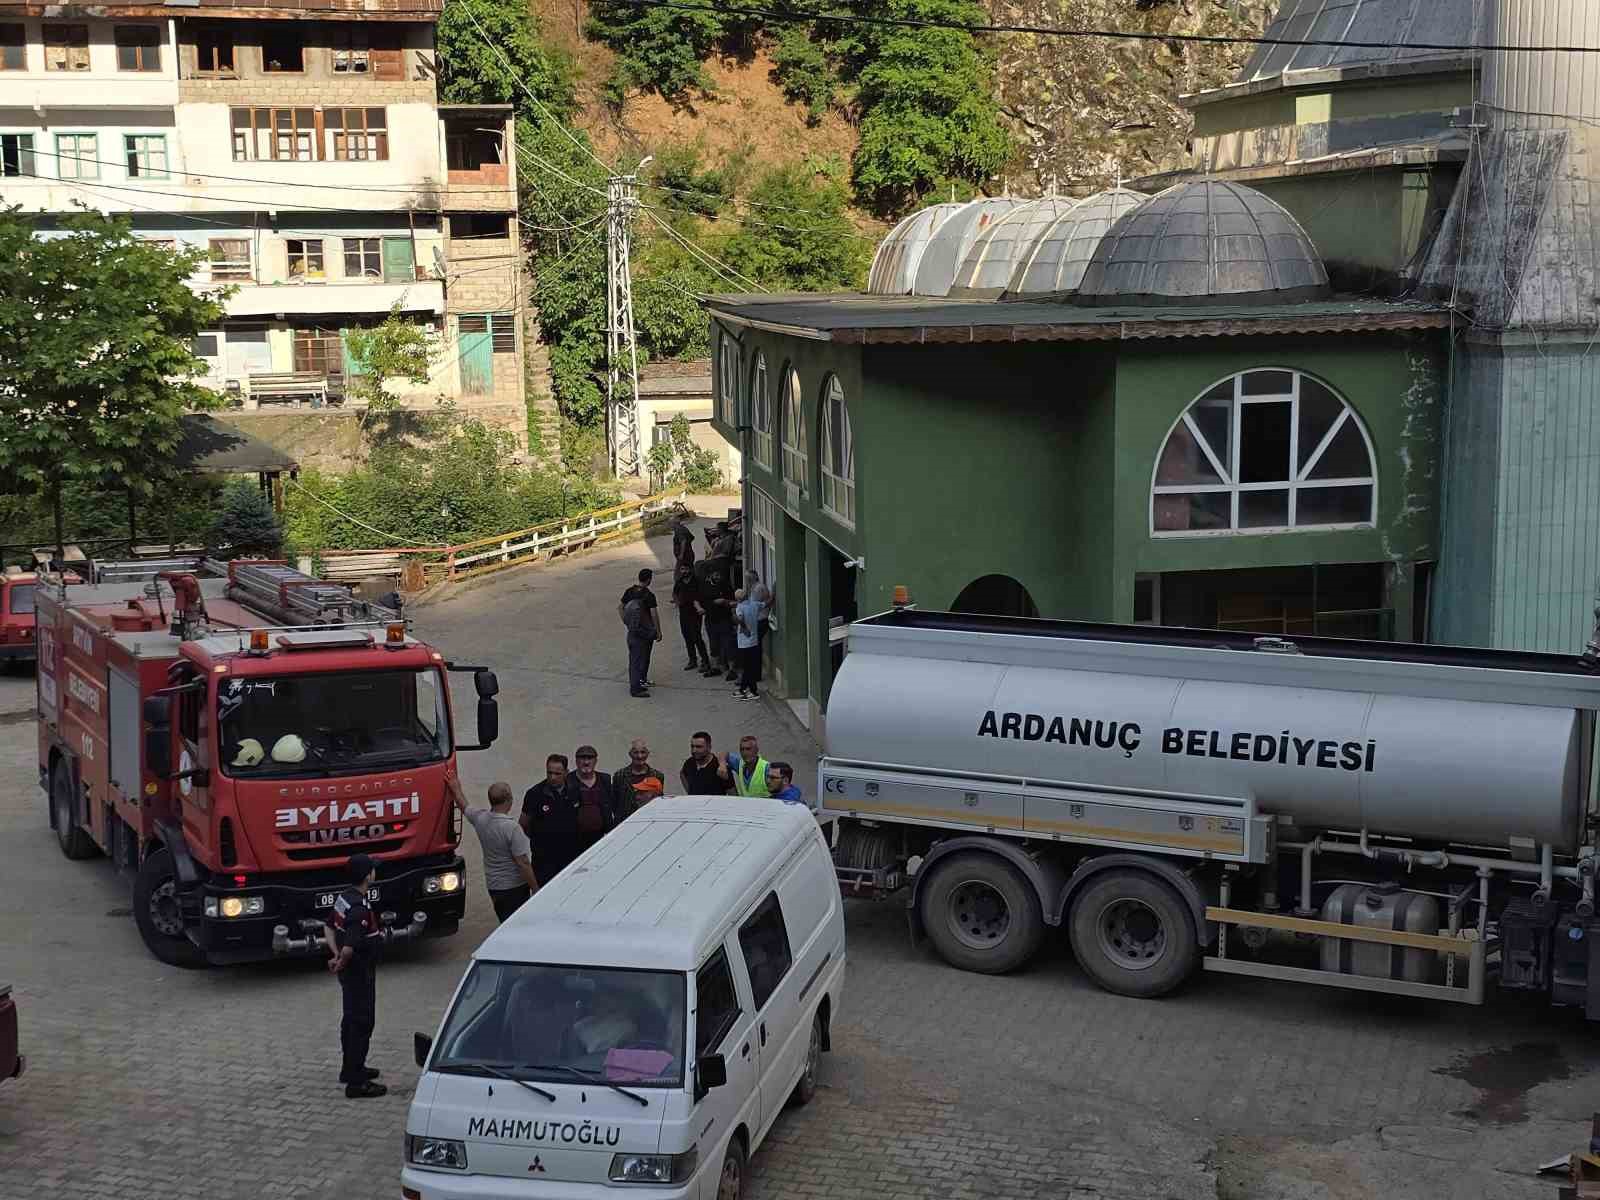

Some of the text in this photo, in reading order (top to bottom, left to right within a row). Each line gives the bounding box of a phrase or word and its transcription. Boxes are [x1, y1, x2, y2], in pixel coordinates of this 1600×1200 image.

[81, 731, 94, 761] 112
[977, 710, 1377, 772] ARDANUÇ BELEDİYESİ
[309, 823, 385, 845] IVECO
[467, 1117, 621, 1146] MAHMUTOĞLU
